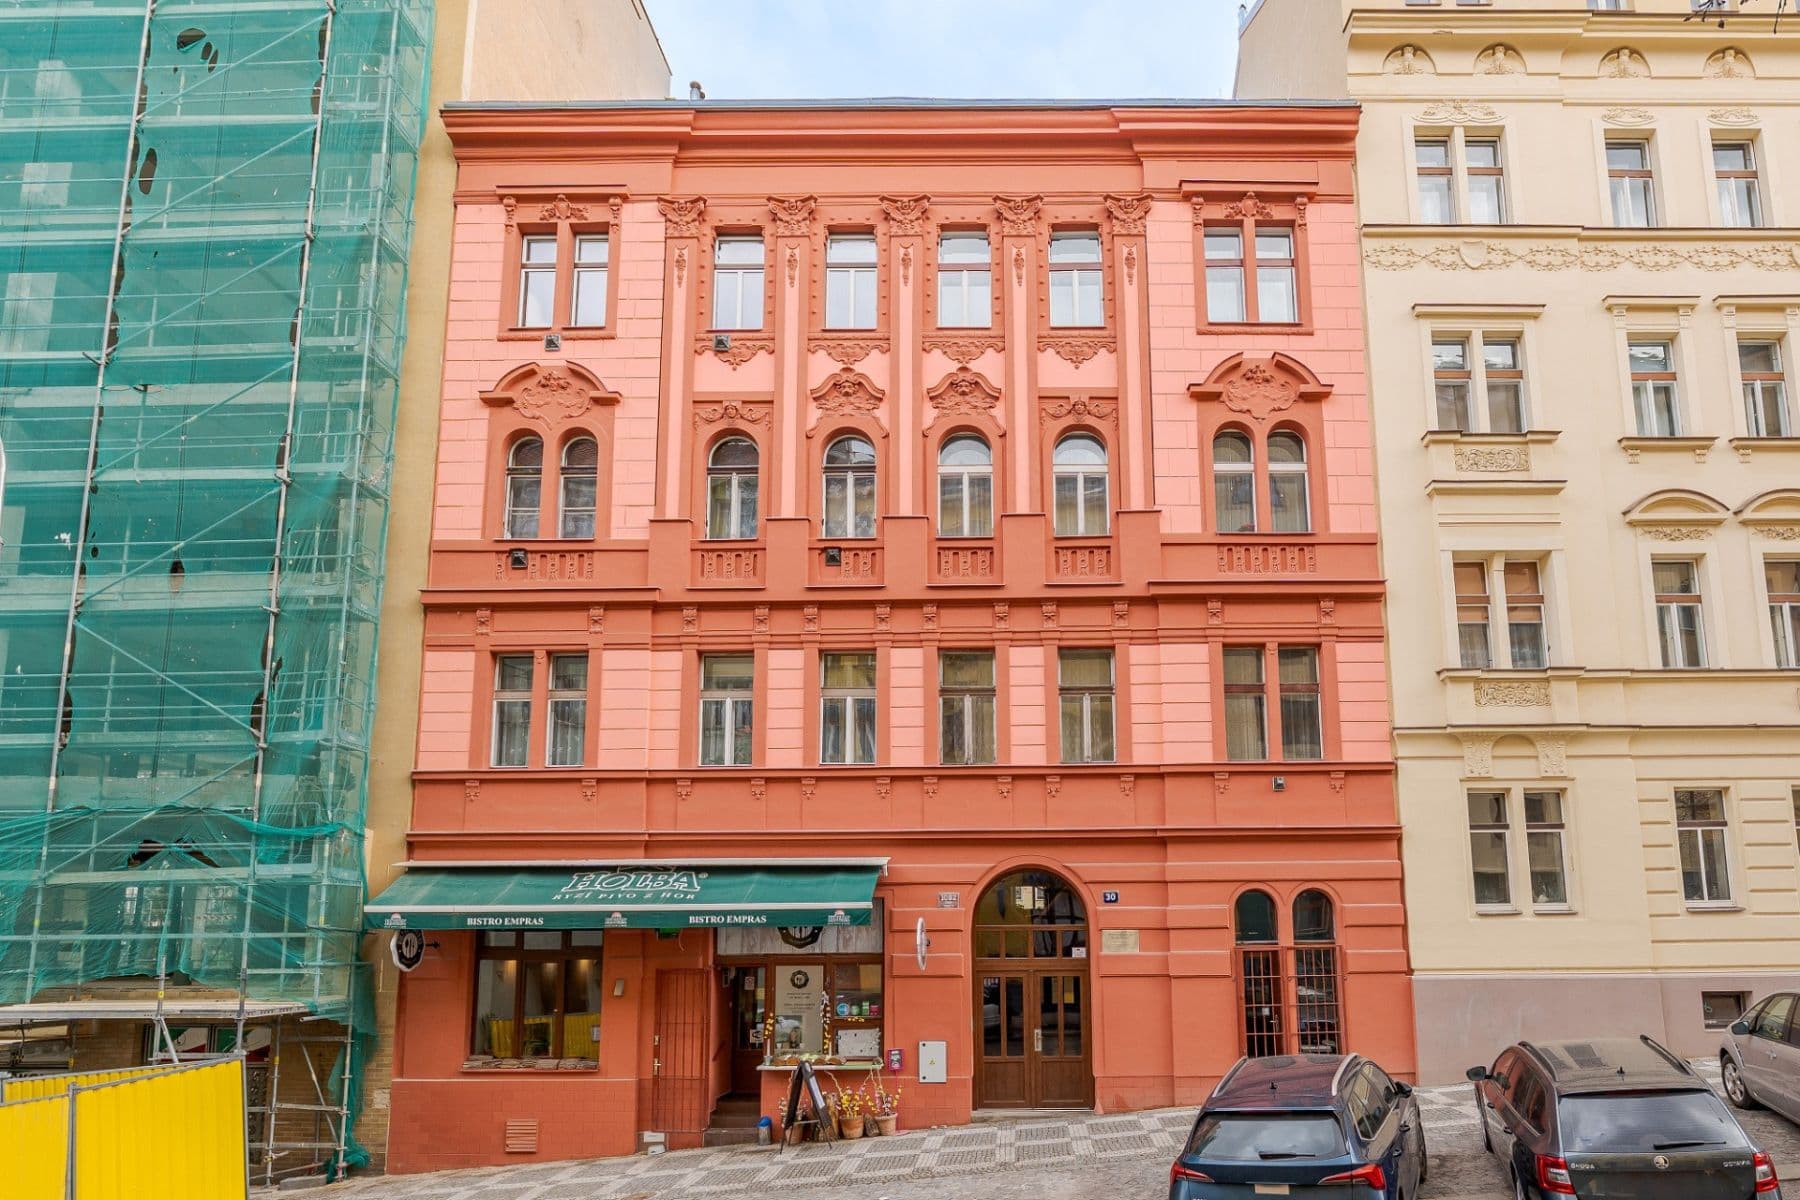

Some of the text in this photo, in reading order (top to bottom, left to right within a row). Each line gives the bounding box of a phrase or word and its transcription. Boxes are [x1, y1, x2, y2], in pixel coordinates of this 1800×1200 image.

[561, 871, 701, 892] HOLBA
[598, 892, 637, 900] PIVO
[659, 891, 696, 900] HOR
[1105, 892, 1116, 901] 30
[466, 917, 544, 926] BISTRO EMPRAS
[688, 914, 767, 924] BISTRO EMPRAS
